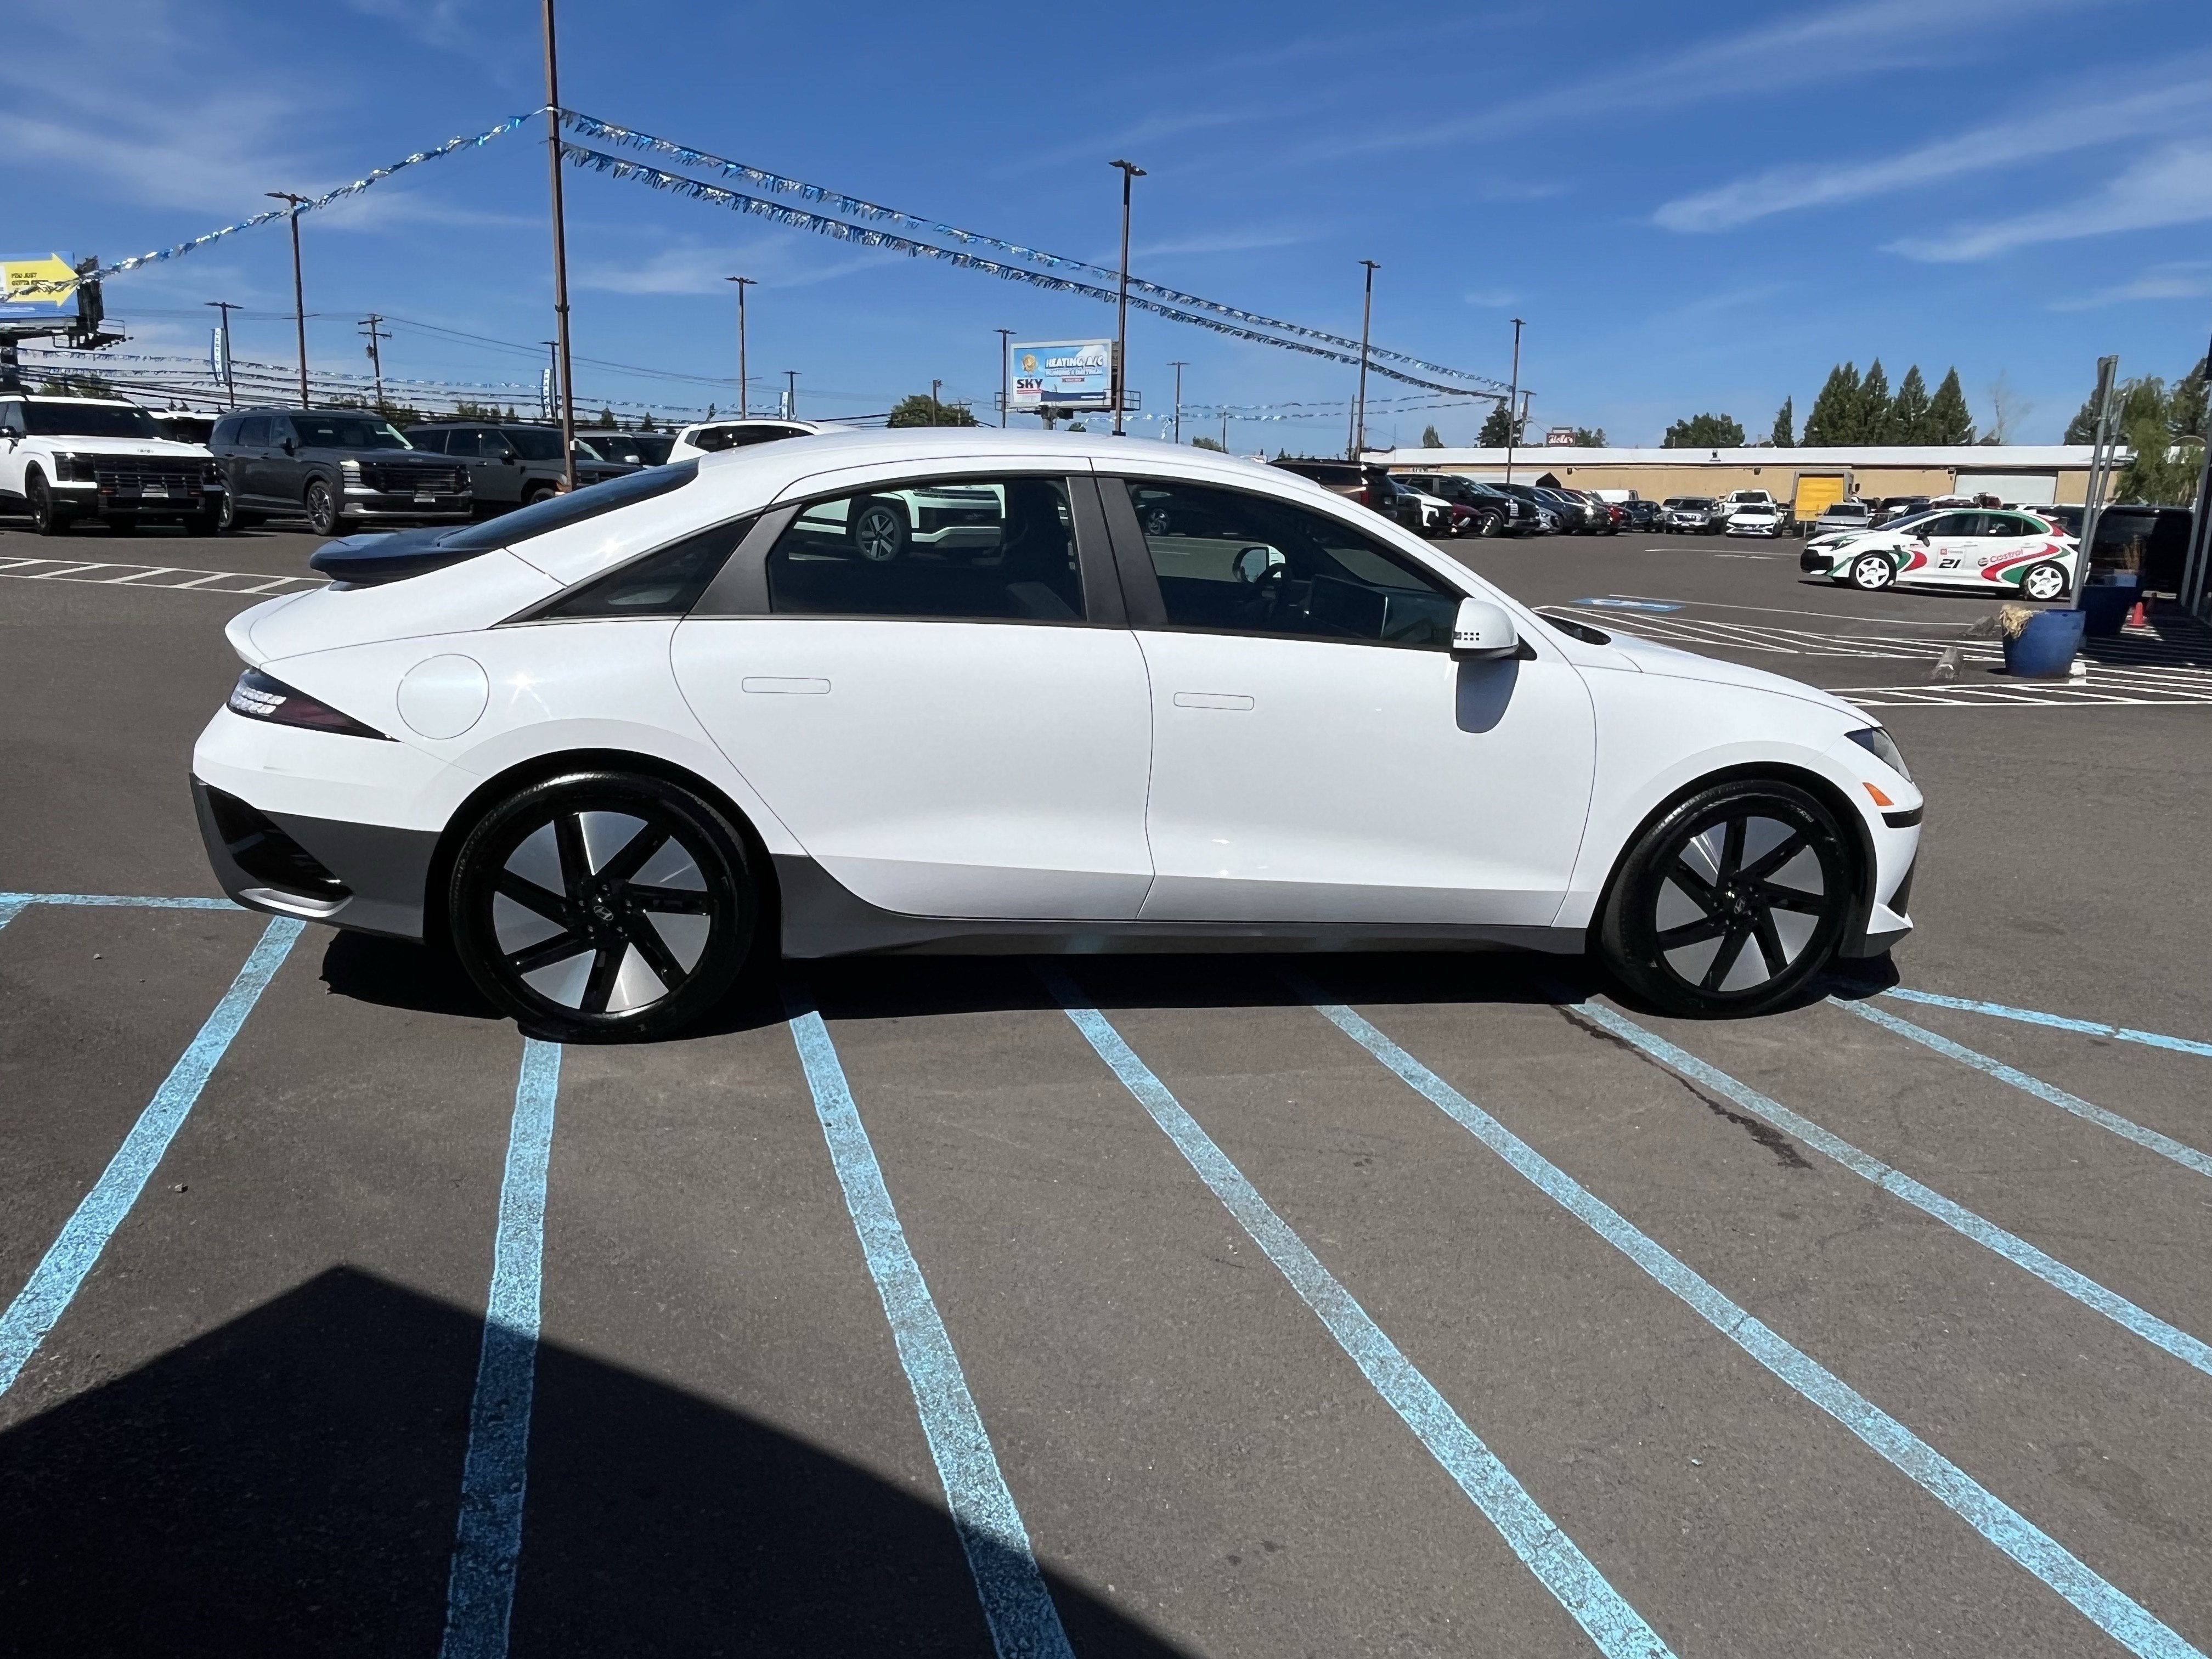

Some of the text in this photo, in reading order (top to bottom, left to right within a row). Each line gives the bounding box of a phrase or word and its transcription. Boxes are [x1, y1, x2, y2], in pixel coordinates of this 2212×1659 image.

[1017, 379, 1043, 388] SKY
[1990, 549, 2023, 562] Castrol
[1938, 558, 1961, 568] 21
